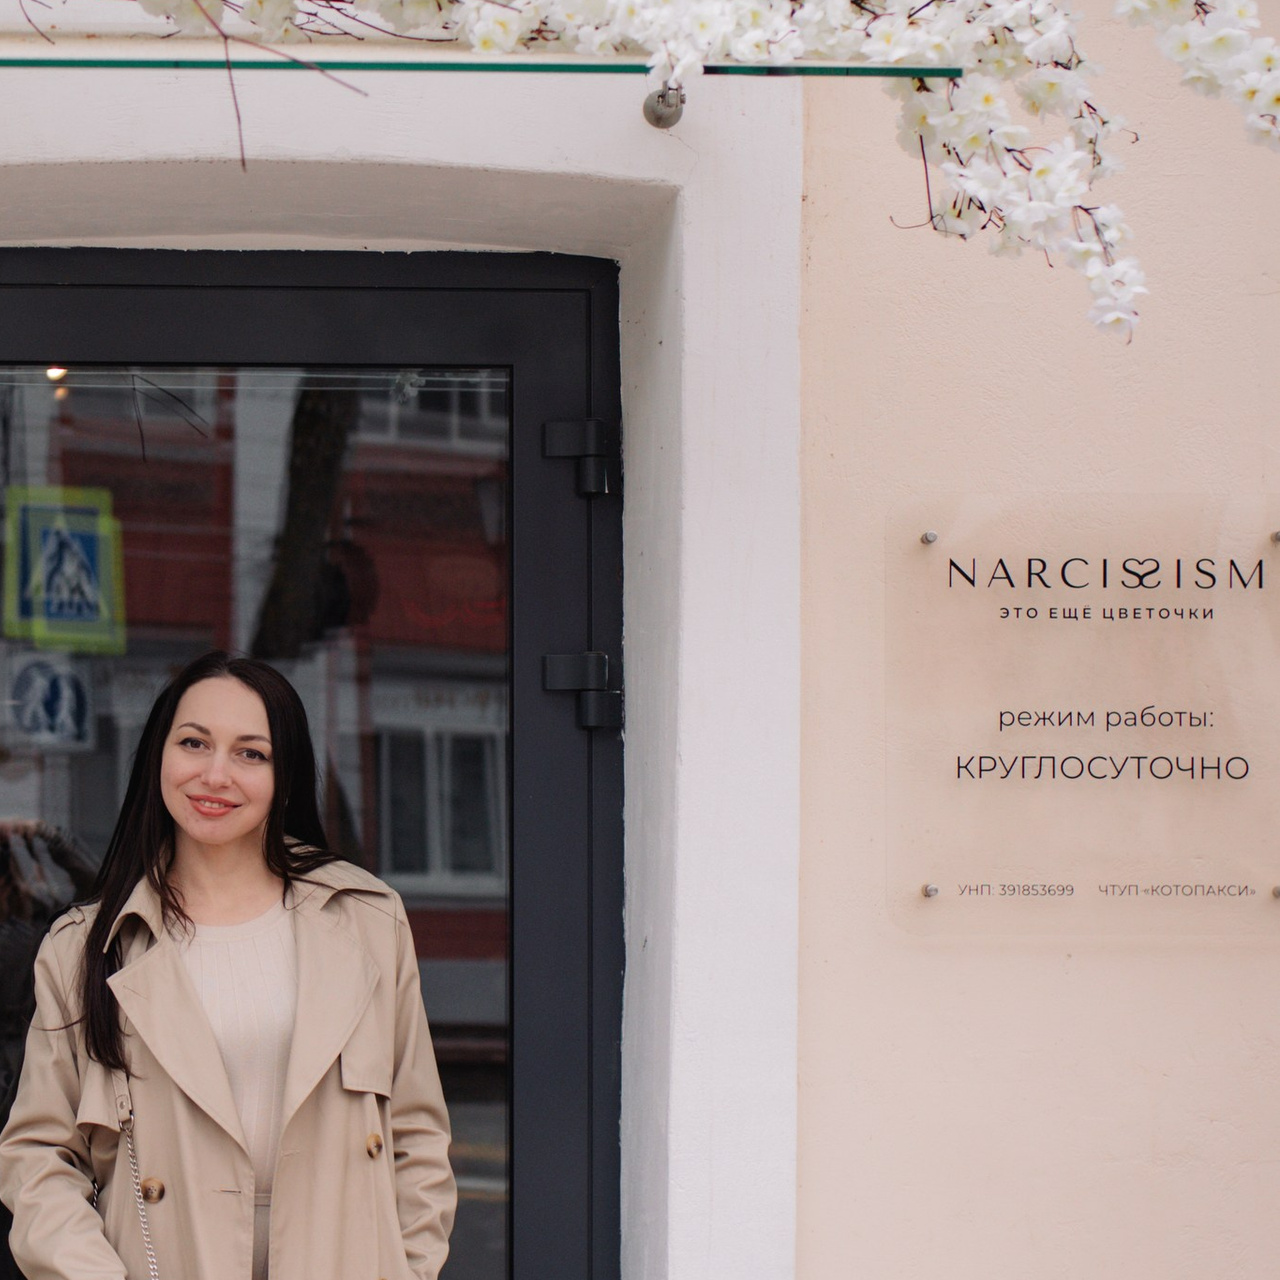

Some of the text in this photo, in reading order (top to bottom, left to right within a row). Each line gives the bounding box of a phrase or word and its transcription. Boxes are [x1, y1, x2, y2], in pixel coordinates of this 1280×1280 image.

[948, 558, 1264, 589] NARCISSISM
[999, 604, 1214, 621] ЭТО ЕЩЁ ЦВЕТОЧКИ
[999, 705, 1214, 731] режим работы:
[956, 756, 1250, 780] КРУГЛОСУТОЧНО
[958, 884, 1257, 897] УНП: 391853699 ЧТУП «КОТОПАКСИ»
